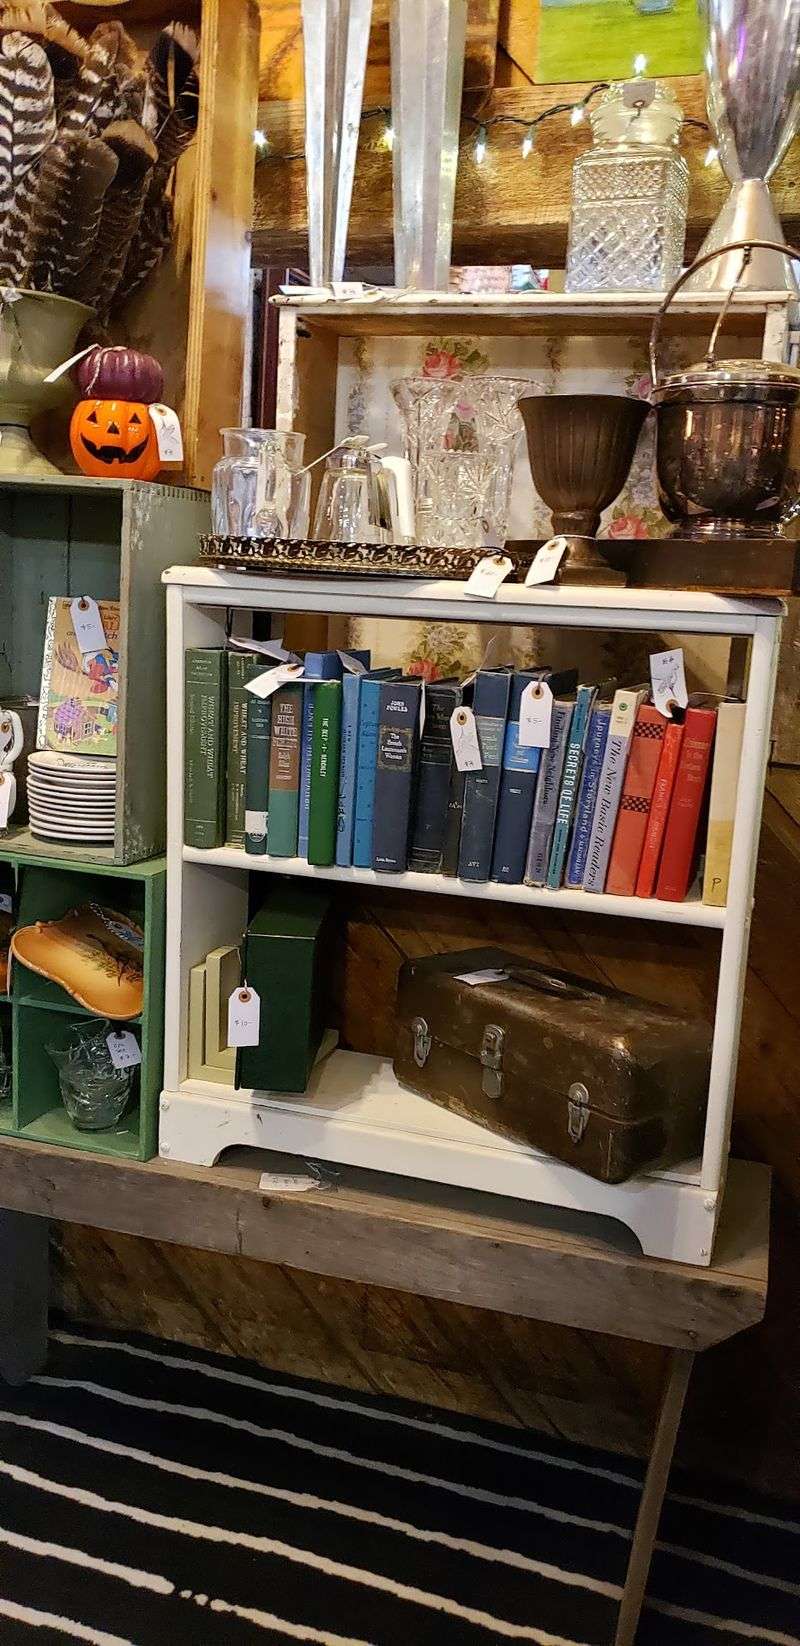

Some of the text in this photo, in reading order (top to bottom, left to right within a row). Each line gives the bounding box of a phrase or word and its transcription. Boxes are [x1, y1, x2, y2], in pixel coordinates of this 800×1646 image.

[200, 694, 208, 755] IMPROVEMENT
[232, 701, 240, 753] IMPROVEMENT
[280, 703, 293, 713] THE
[274, 726, 297, 737] WHITE
[590, 716, 609, 766] Journeys
[563, 743, 581, 786] SECRETS
[557, 803, 571, 824] LIFE
[561, 789, 573, 801] OF
[581, 781, 598, 833] Storyland
[588, 740, 622, 887] The New Basic Readers
[712, 877, 722, 893] P
